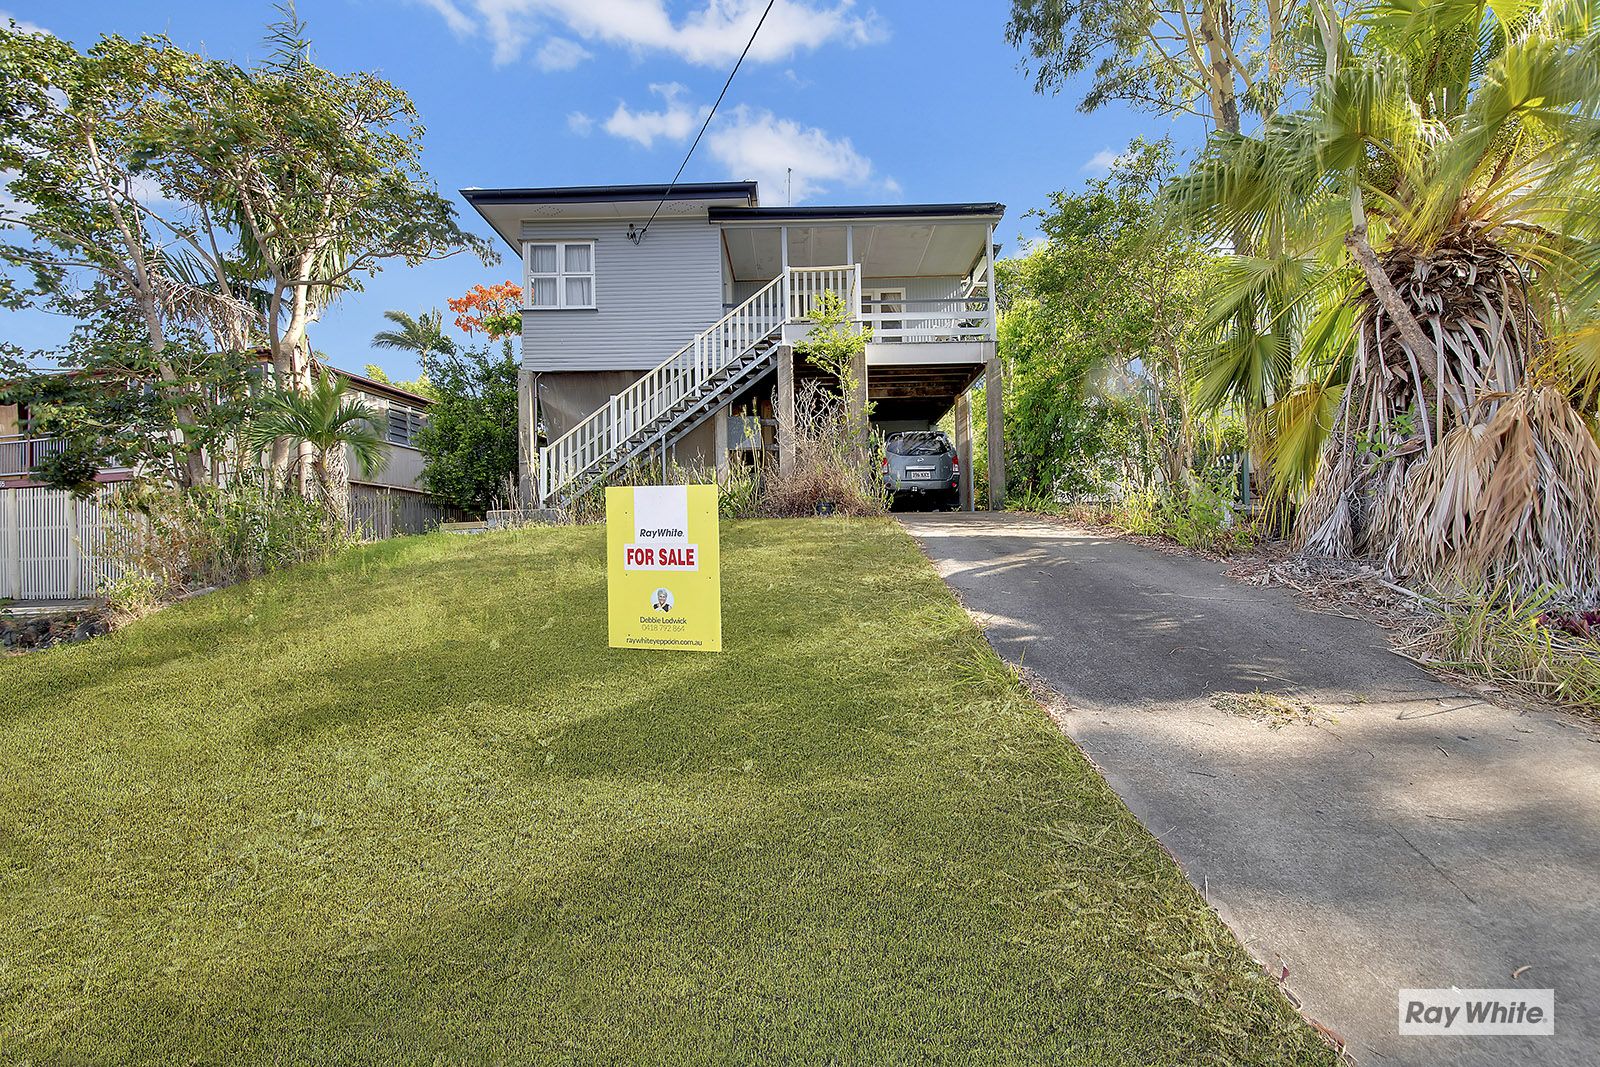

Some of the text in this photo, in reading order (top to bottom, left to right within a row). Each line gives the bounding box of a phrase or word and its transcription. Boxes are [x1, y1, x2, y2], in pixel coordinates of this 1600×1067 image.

[626, 548, 695, 566] FOR SALE
[639, 616, 687, 625] Debbie Lodwick
[626, 637, 703, 647] raywhiteyeppoon.com.au
